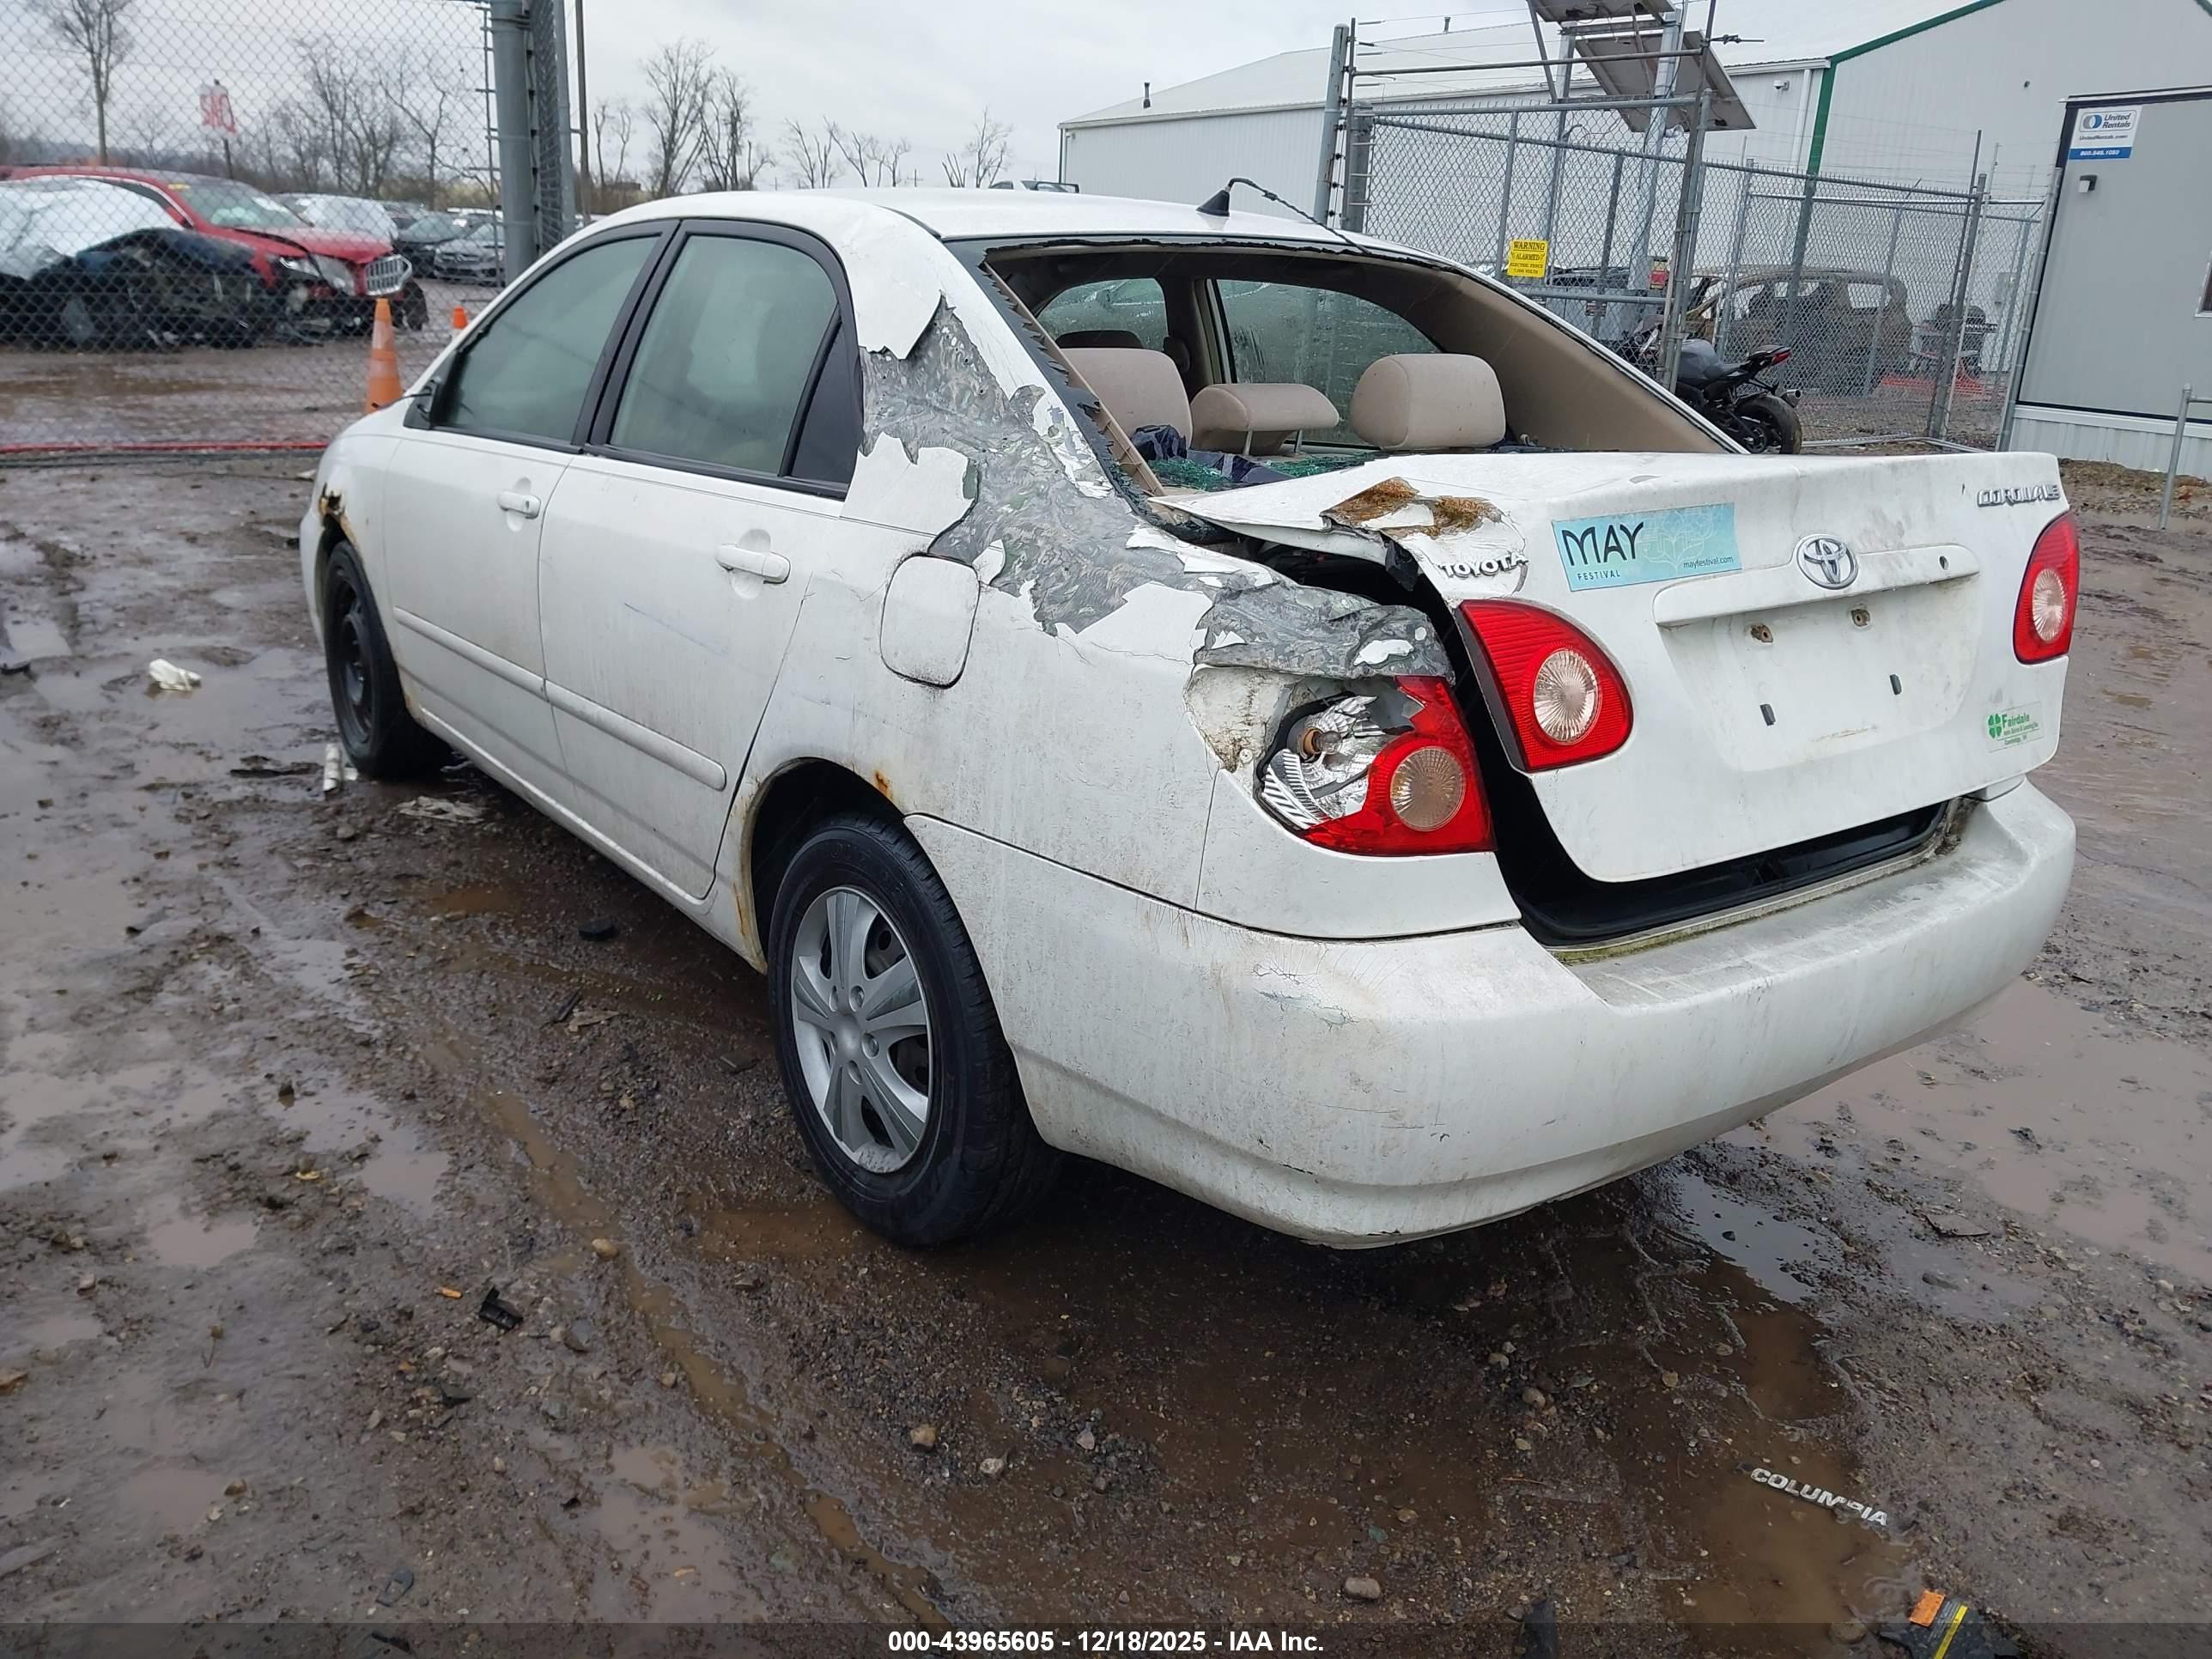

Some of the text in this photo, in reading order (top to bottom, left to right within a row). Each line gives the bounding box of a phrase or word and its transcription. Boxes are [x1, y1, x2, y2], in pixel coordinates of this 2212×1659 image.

[1514, 241, 1545, 251] WARNING
[1978, 486, 2042, 507] COROLLA
[1561, 521, 1644, 566] MAY
[1438, 550, 1528, 578] TOYOTA
[1683, 556, 1734, 569] mayfestival.com
[1577, 570, 1621, 580] FESTIVAL
[2002, 712, 2030, 728] Fairdale
